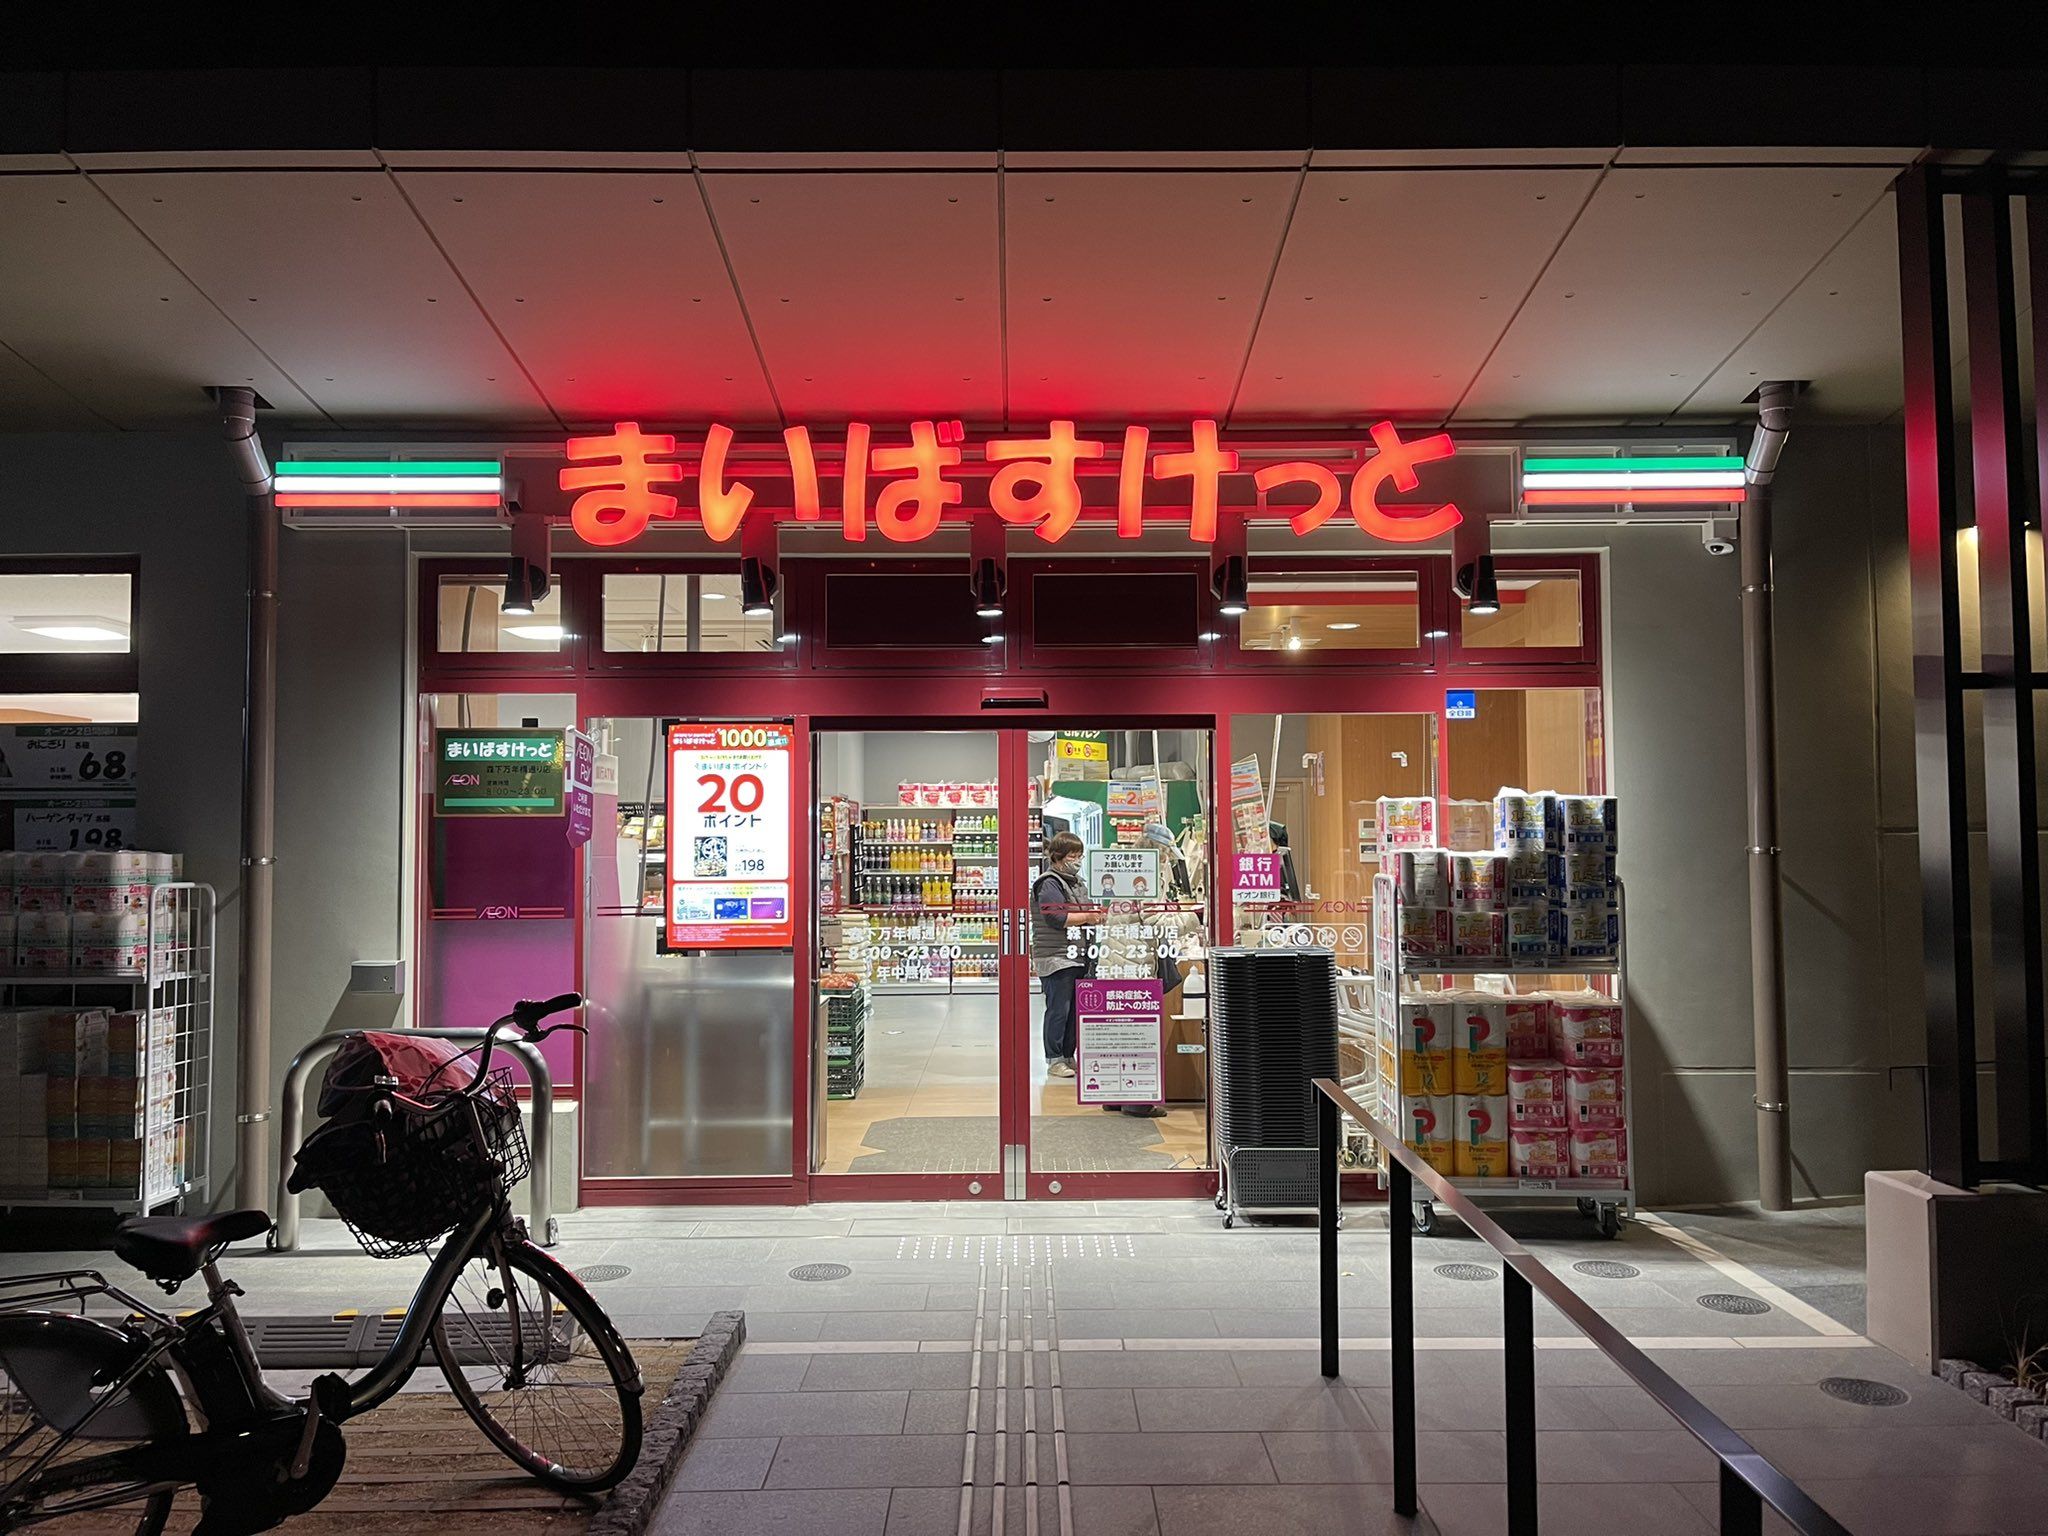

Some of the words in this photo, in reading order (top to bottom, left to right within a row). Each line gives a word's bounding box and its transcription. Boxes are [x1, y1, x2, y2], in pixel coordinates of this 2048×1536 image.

[559, 419, 1464, 546] まいばすけっと
[718, 728, 767, 747] 1000
[446, 742, 553, 759] まいばすけっと
[79, 750, 126, 780] 68
[696, 773, 765, 813] 20
[704, 814, 762, 828] ポイント
[1104, 853, 1143, 861] マスク着用を
[742, 859, 765, 872] 198
[1104, 861, 1143, 869] お願いします
[1238, 857, 1273, 872] 銀行
[1239, 874, 1274, 887] ATM
[1236, 890, 1276, 900] イオン銀行
[1066, 925, 1179, 941] 森下万年橋通り店
[1095, 964, 1152, 979] 年中無休
[1105, 990, 1152, 1000] 感染症拡大
[1105, 1001, 1160, 1011] 防止への対応
